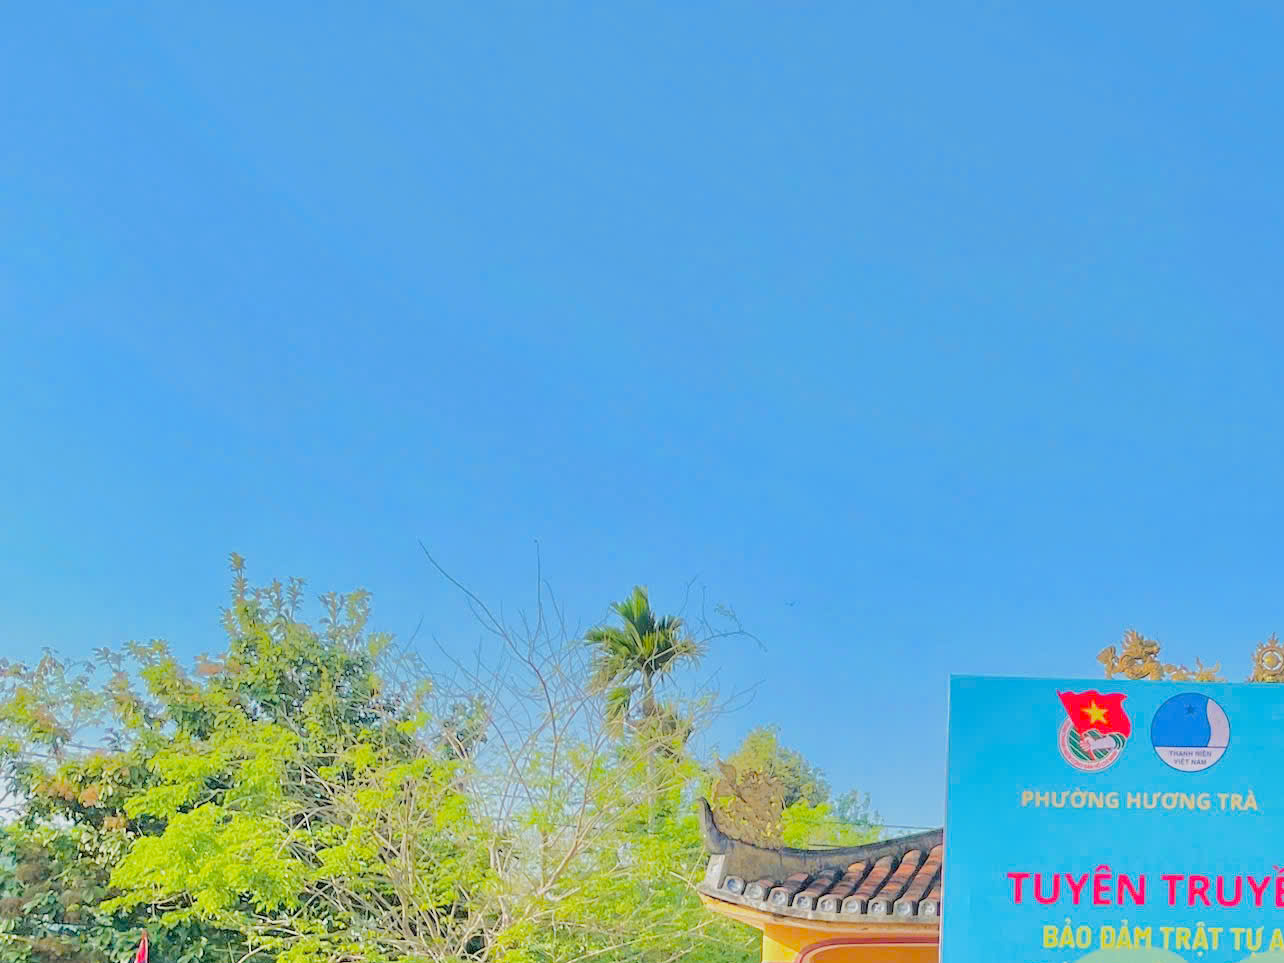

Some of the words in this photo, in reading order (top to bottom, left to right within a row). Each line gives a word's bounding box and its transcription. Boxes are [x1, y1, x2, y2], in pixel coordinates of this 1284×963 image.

[1021, 787, 1120, 809] PHƯỜNG
[1126, 790, 1212, 811] HƯƠNG
[1217, 789, 1259, 811] TRÀ
[1007, 864, 1147, 906] TUYÊN
[1042, 917, 1092, 949] BẢO
[1100, 918, 1153, 950] ĐẢM
[1160, 921, 1224, 956] TRẬT
[1229, 925, 1265, 959] TỰ
